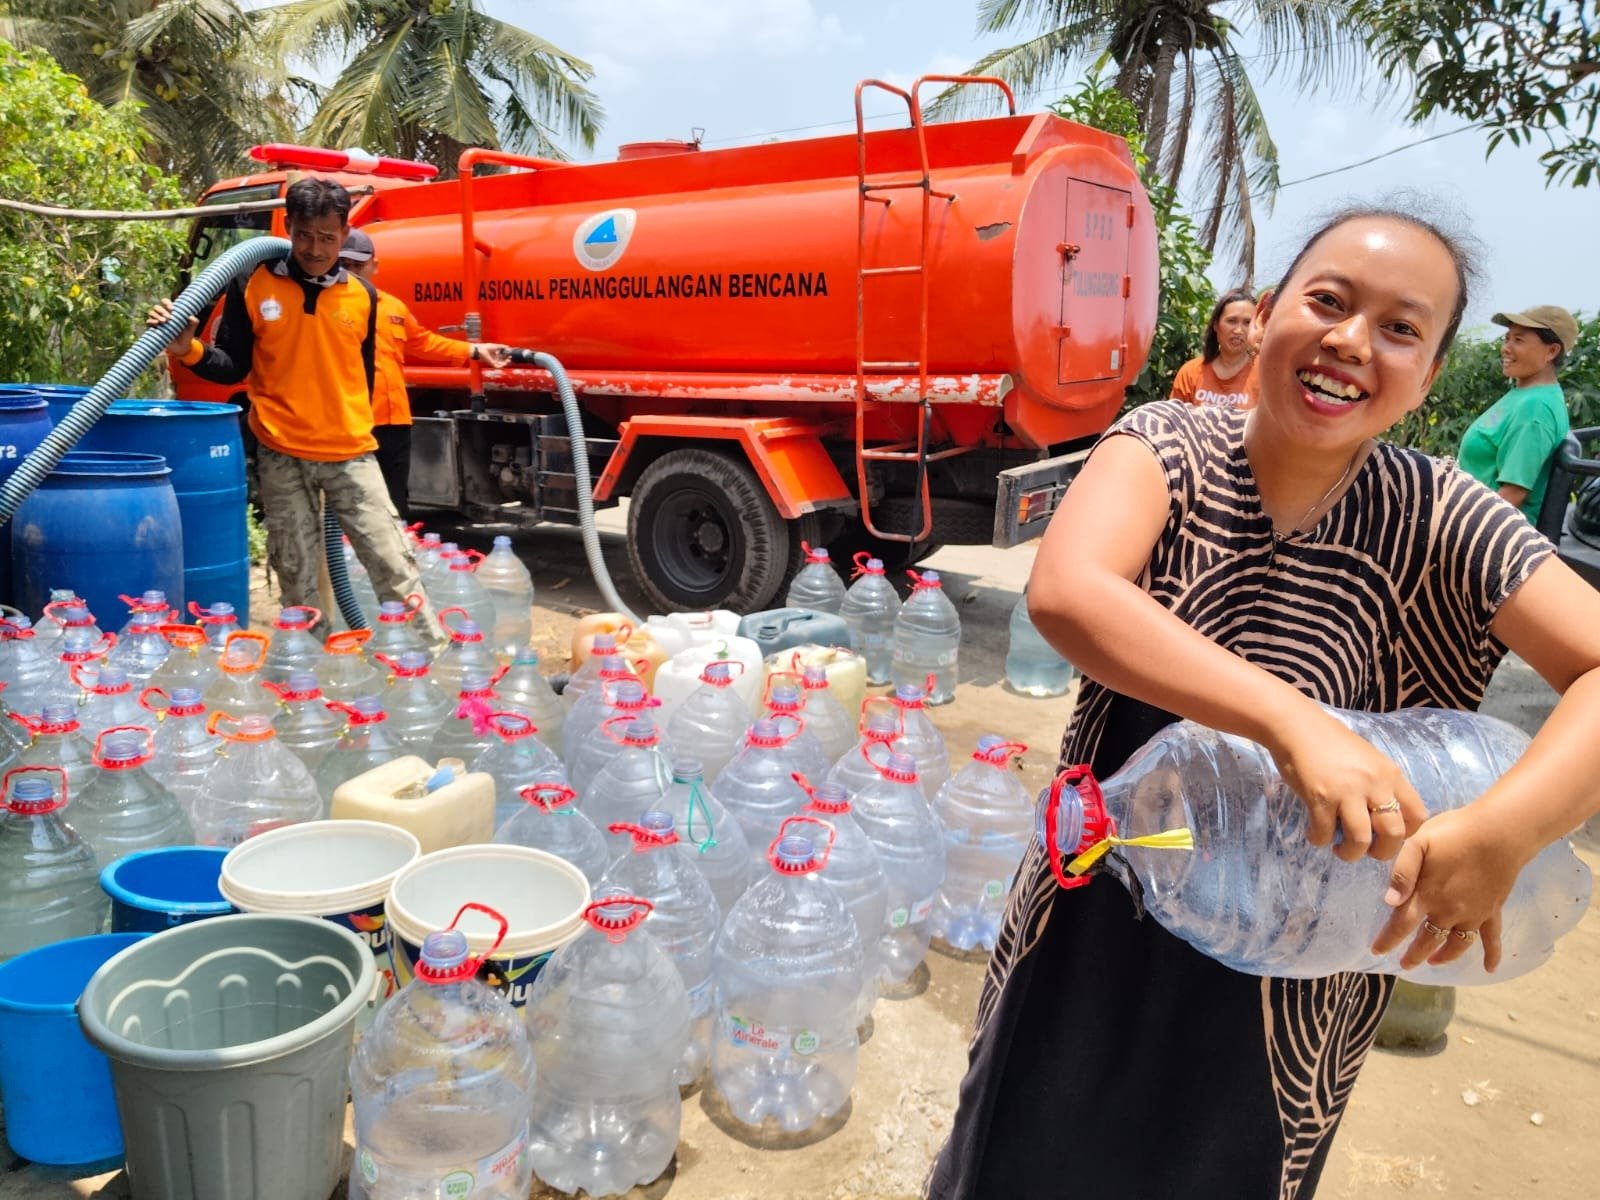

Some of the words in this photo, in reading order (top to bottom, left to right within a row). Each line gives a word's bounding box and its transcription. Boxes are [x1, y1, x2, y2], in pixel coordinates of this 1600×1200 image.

[414, 281, 463, 302] BADAN
[478, 279, 544, 301] ASIONAL
[549, 274, 722, 299] PENANGGULANGAN
[728, 271, 828, 298] BENCANA
[209, 444, 231, 459] RT2
[751, 1023, 765, 1037] Le
[733, 1029, 779, 1049] Minerale
